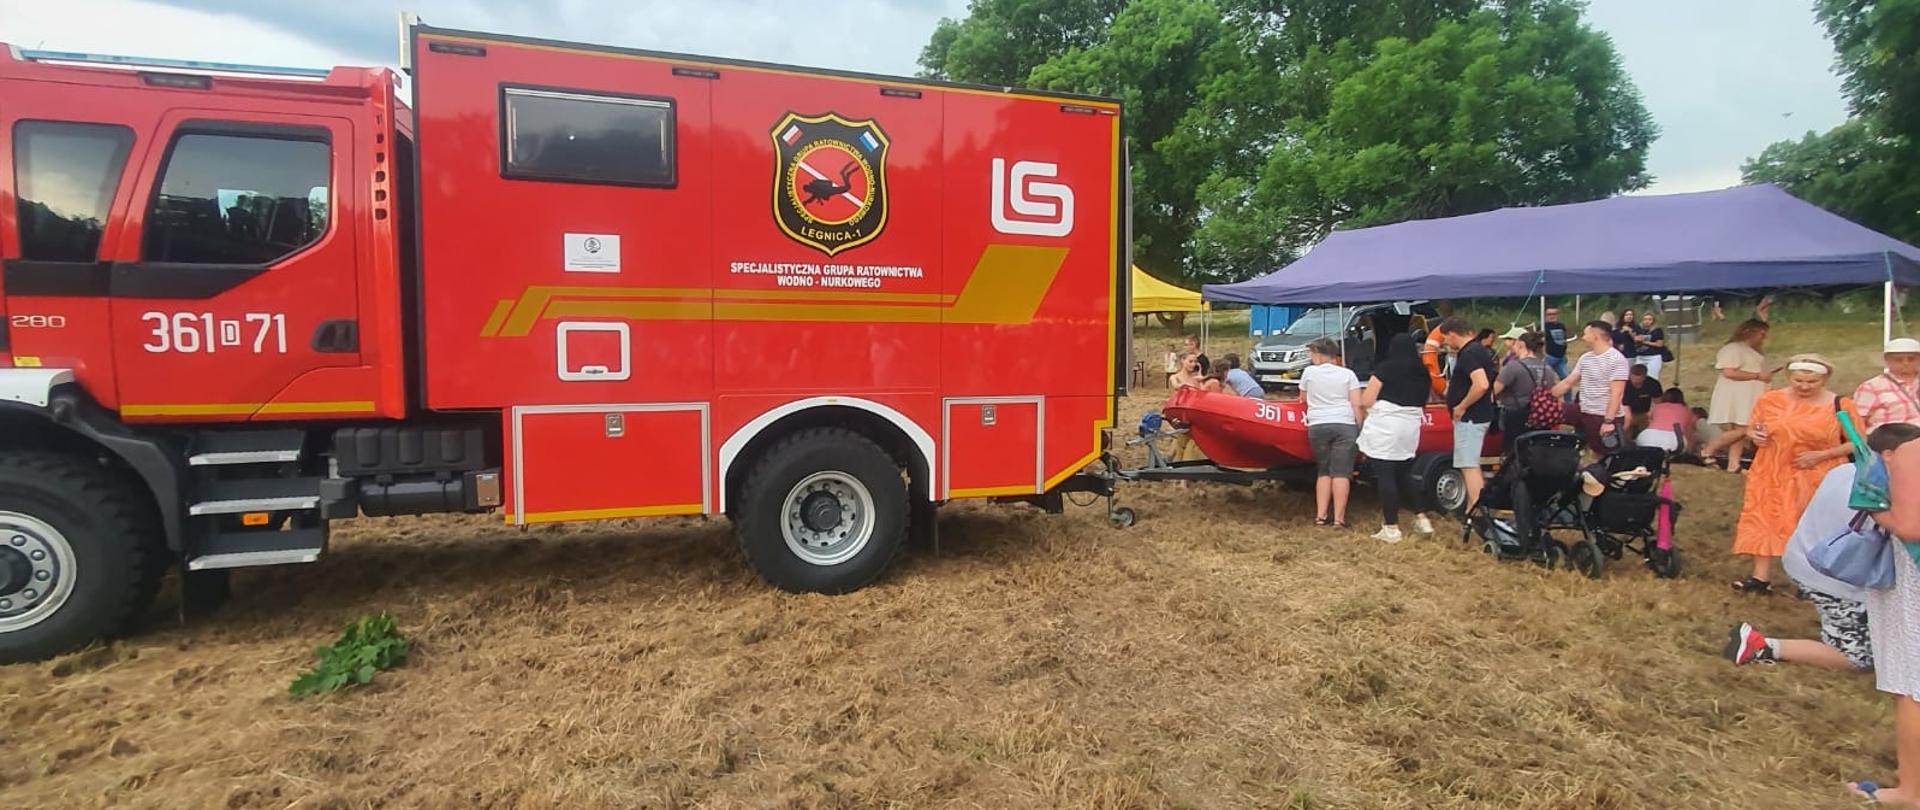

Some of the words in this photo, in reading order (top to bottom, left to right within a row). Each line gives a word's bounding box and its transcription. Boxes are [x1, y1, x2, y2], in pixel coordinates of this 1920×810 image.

[801, 226, 862, 241] LEGNICA-1
[730, 262, 821, 275] SPECJALISTYCZNA
[823, 264, 854, 276] GRUPA
[857, 265, 923, 278] RATOWNICTWA
[777, 275, 813, 287] WODNO
[821, 276, 881, 288] NURKOWEGO
[11, 315, 66, 328] 280
[142, 311, 215, 353] 361
[245, 313, 287, 353] 71
[1255, 402, 1281, 423] 361
